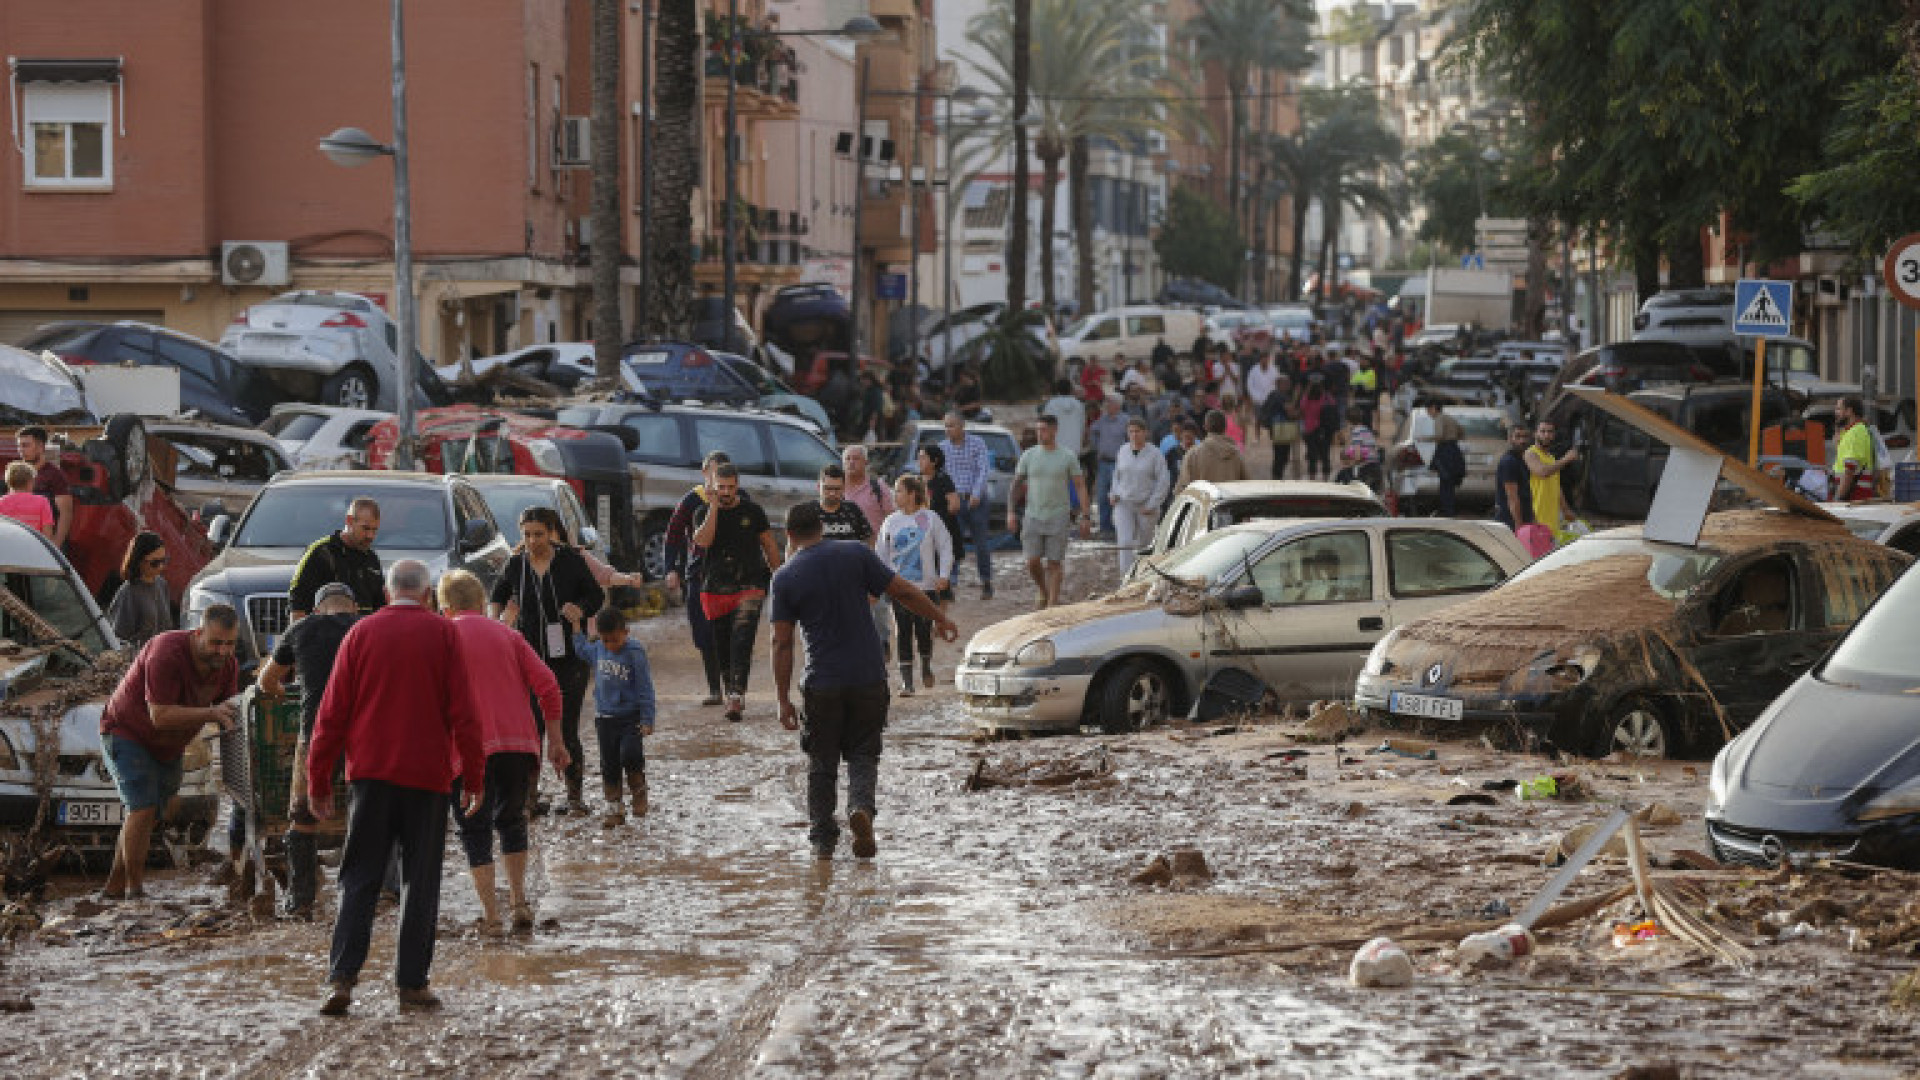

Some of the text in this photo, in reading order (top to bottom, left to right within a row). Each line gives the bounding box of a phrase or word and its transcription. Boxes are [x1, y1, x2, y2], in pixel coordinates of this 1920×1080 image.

[1902, 259, 1920, 283] 3
[1432, 699, 1457, 718] FFL
[69, 804, 110, 821] 9051
